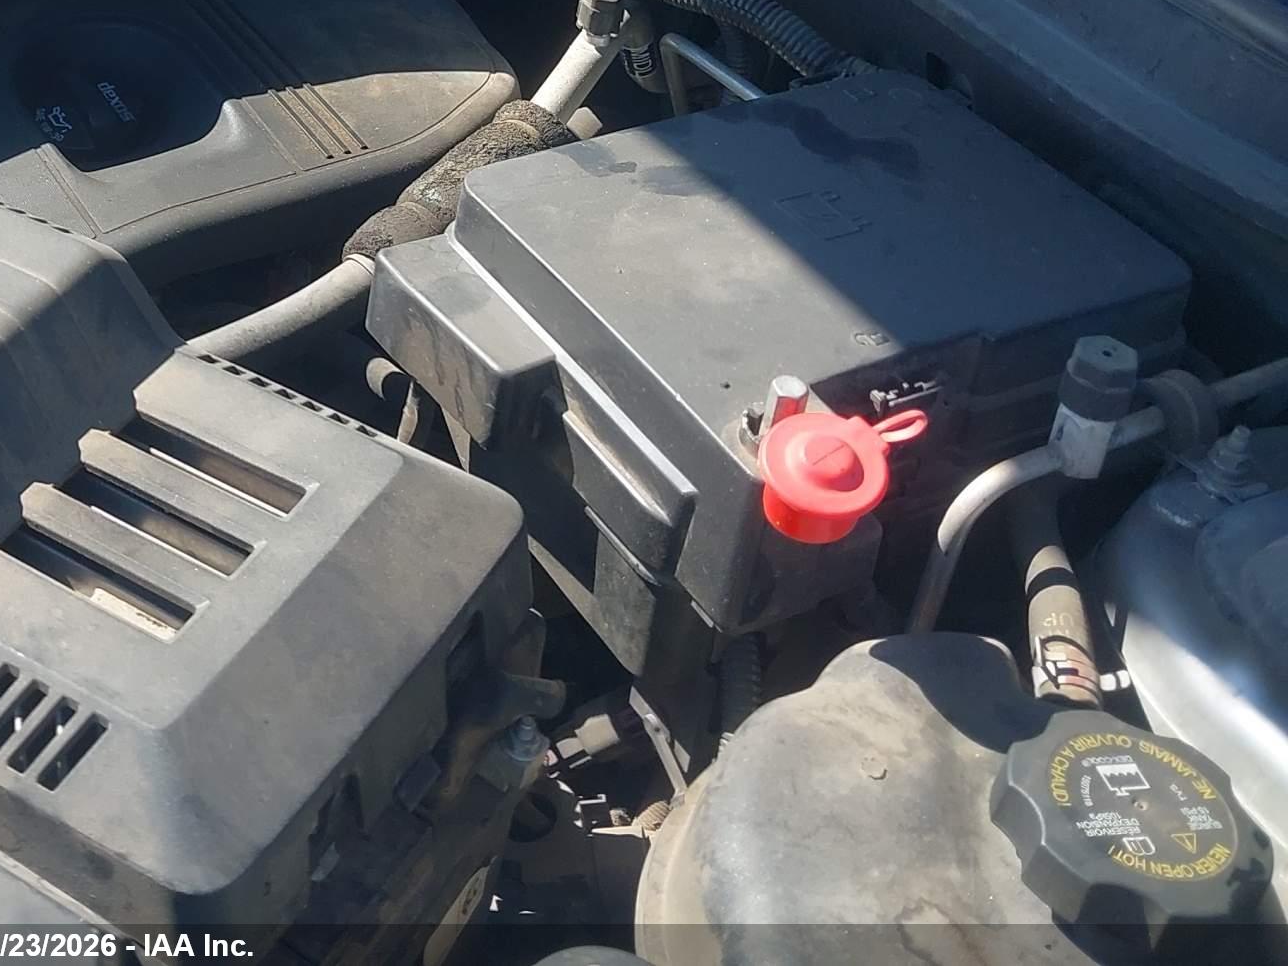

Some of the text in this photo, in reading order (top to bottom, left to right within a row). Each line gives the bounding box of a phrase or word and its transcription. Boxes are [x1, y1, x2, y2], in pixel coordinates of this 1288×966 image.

[98, 82, 134, 122] dexos
[1068, 734, 1132, 752] OUVRIR
[1139, 740, 1197, 777] JAMAIS
[1192, 779, 1216, 799] NE
[1150, 861, 1194, 878] OPEN
[1190, 843, 1231, 874] NEVER
